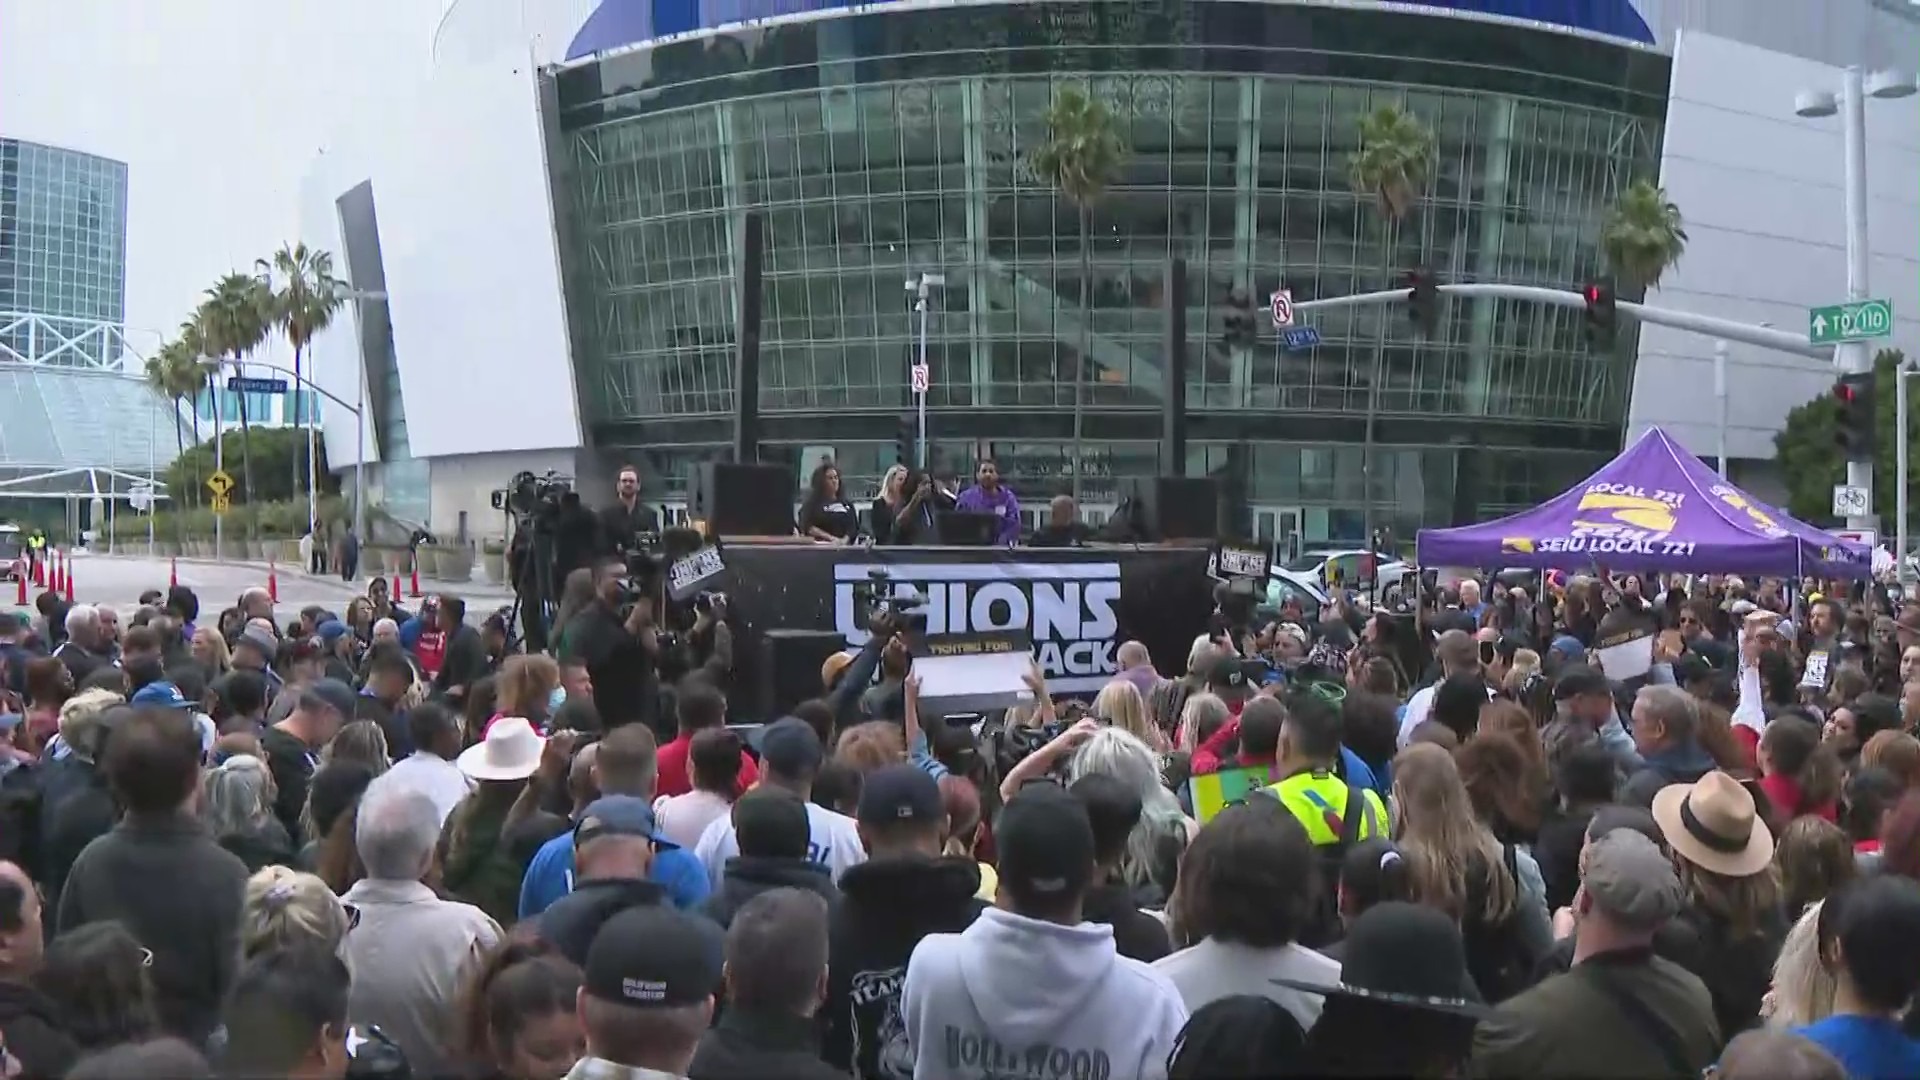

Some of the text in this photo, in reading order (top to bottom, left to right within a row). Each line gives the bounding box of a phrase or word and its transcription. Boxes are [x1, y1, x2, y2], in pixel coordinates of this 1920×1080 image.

[1832, 310, 1882, 333] TO 110
[1585, 483, 1686, 508] LOCAL 721
[1538, 537, 1696, 556] SEIU LOCAL 721
[836, 580, 1121, 646] UNIONS
[1032, 641, 1116, 676] ACK
